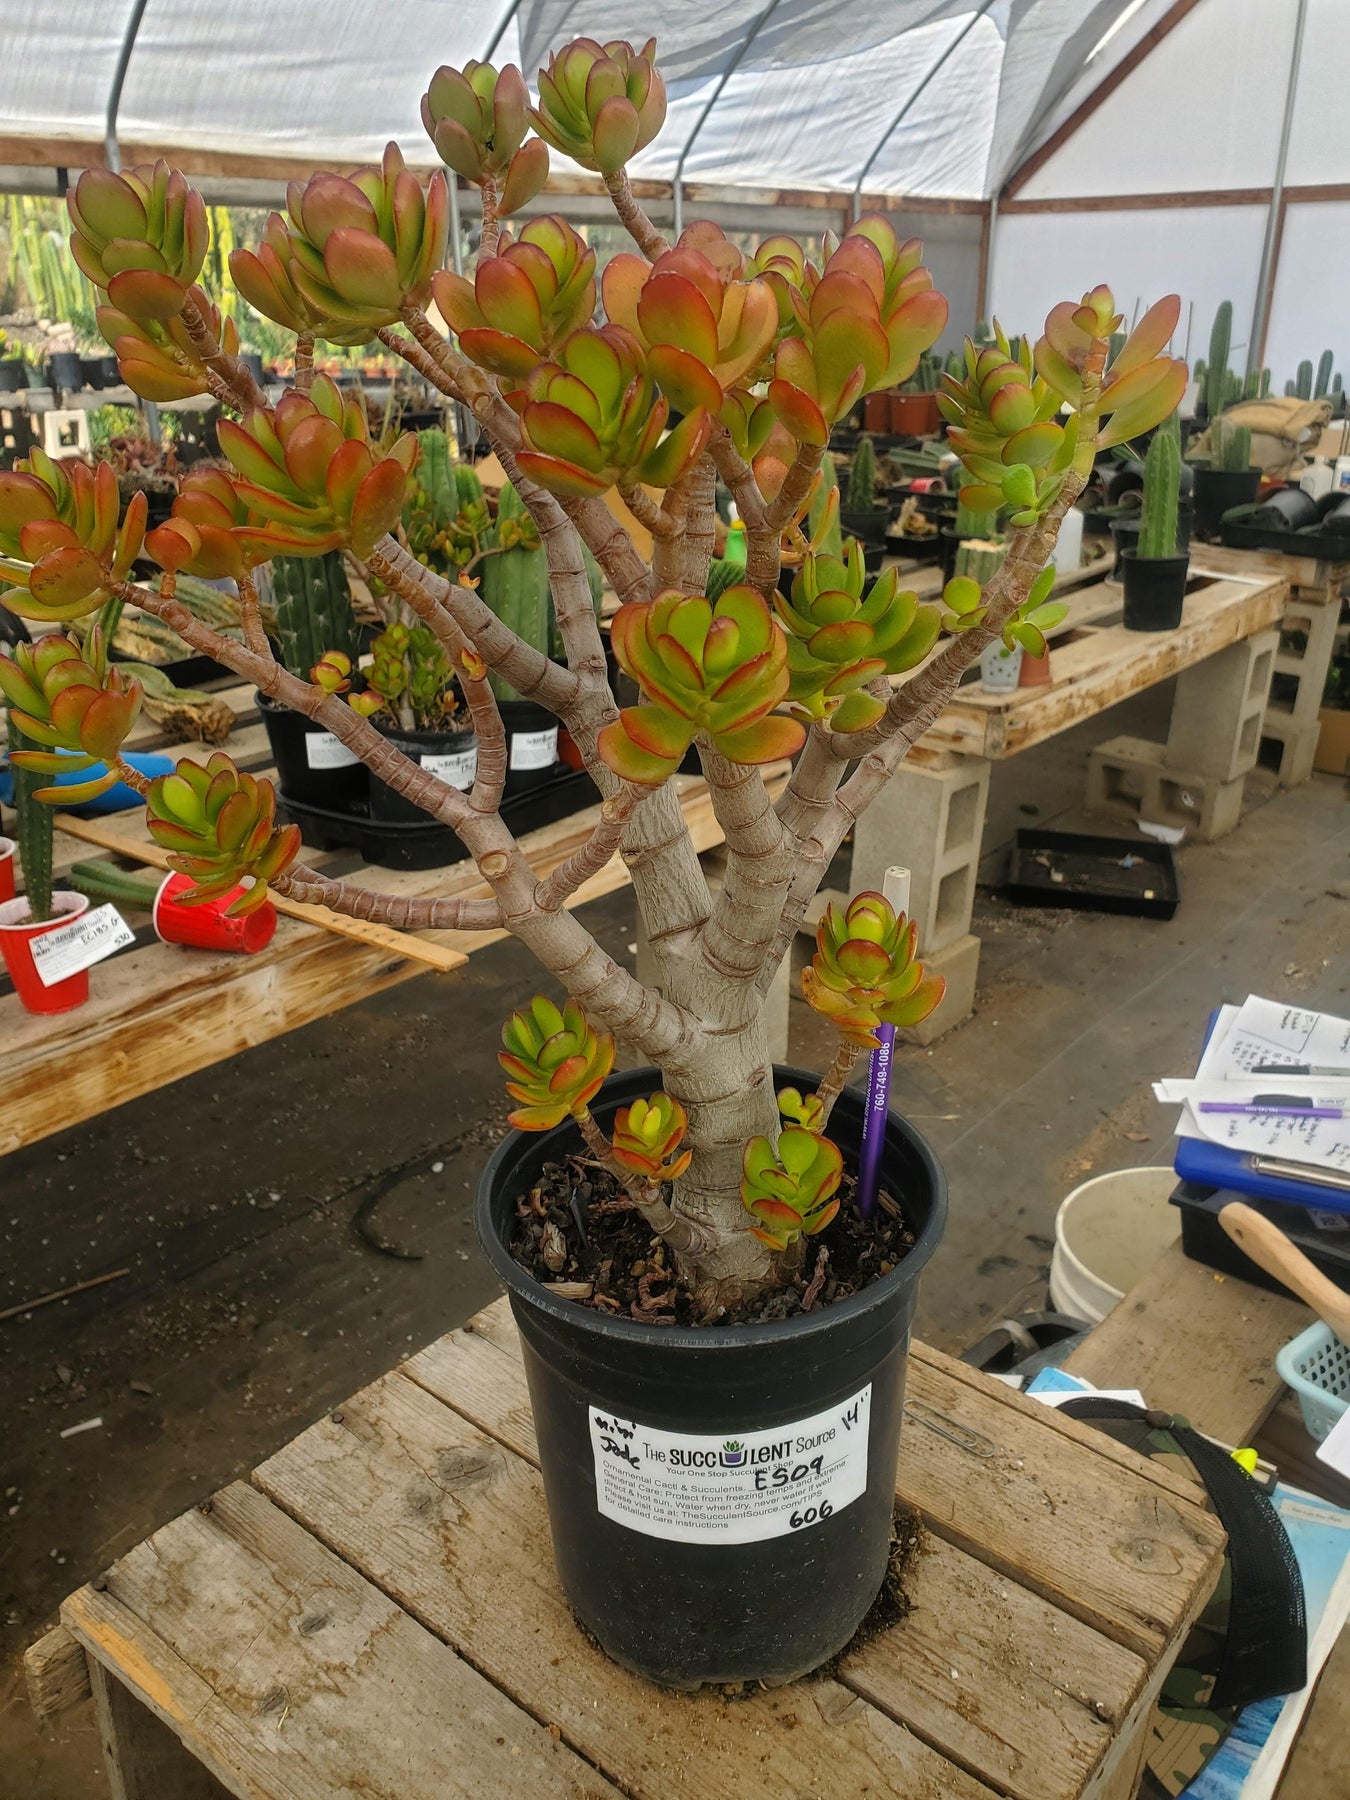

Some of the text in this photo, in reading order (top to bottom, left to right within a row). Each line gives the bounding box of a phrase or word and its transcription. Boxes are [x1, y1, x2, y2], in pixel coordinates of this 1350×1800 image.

[873, 1041, 891, 1112] 760-749-1086
[796, 1428, 836, 1454] Source
[602, 1459, 652, 1485] Ornamental
[654, 1479, 678, 1491] Cacti
[680, 1484, 688, 1492] &
[603, 1469, 636, 1489] General
[665, 1490, 699, 1502] Protect
[701, 1494, 723, 1503] from
[725, 1491, 764, 1502] freezing
[766, 1484, 794, 1497] temps
[796, 1476, 813, 1487] and
[814, 1460, 846, 1481] extreme
[666, 1466, 685, 1476] Your
[687, 1469, 706, 1478] One
[707, 1470, 728, 1478] Stop
[603, 1478, 626, 1494] direct
[628, 1489, 635, 1497] &
[636, 1491, 651, 1502] hot
[675, 1500, 704, 1511] Water
[705, 1503, 732, 1512] when
[754, 1497, 780, 1508] never
[782, 1488, 807, 1501] water
[604, 1486, 632, 1504] Please
[634, 1500, 652, 1512] visit
[653, 1507, 665, 1515] us
[605, 1494, 729, 1529] for detailed care instructions
[789, 1499, 833, 1529] 606
